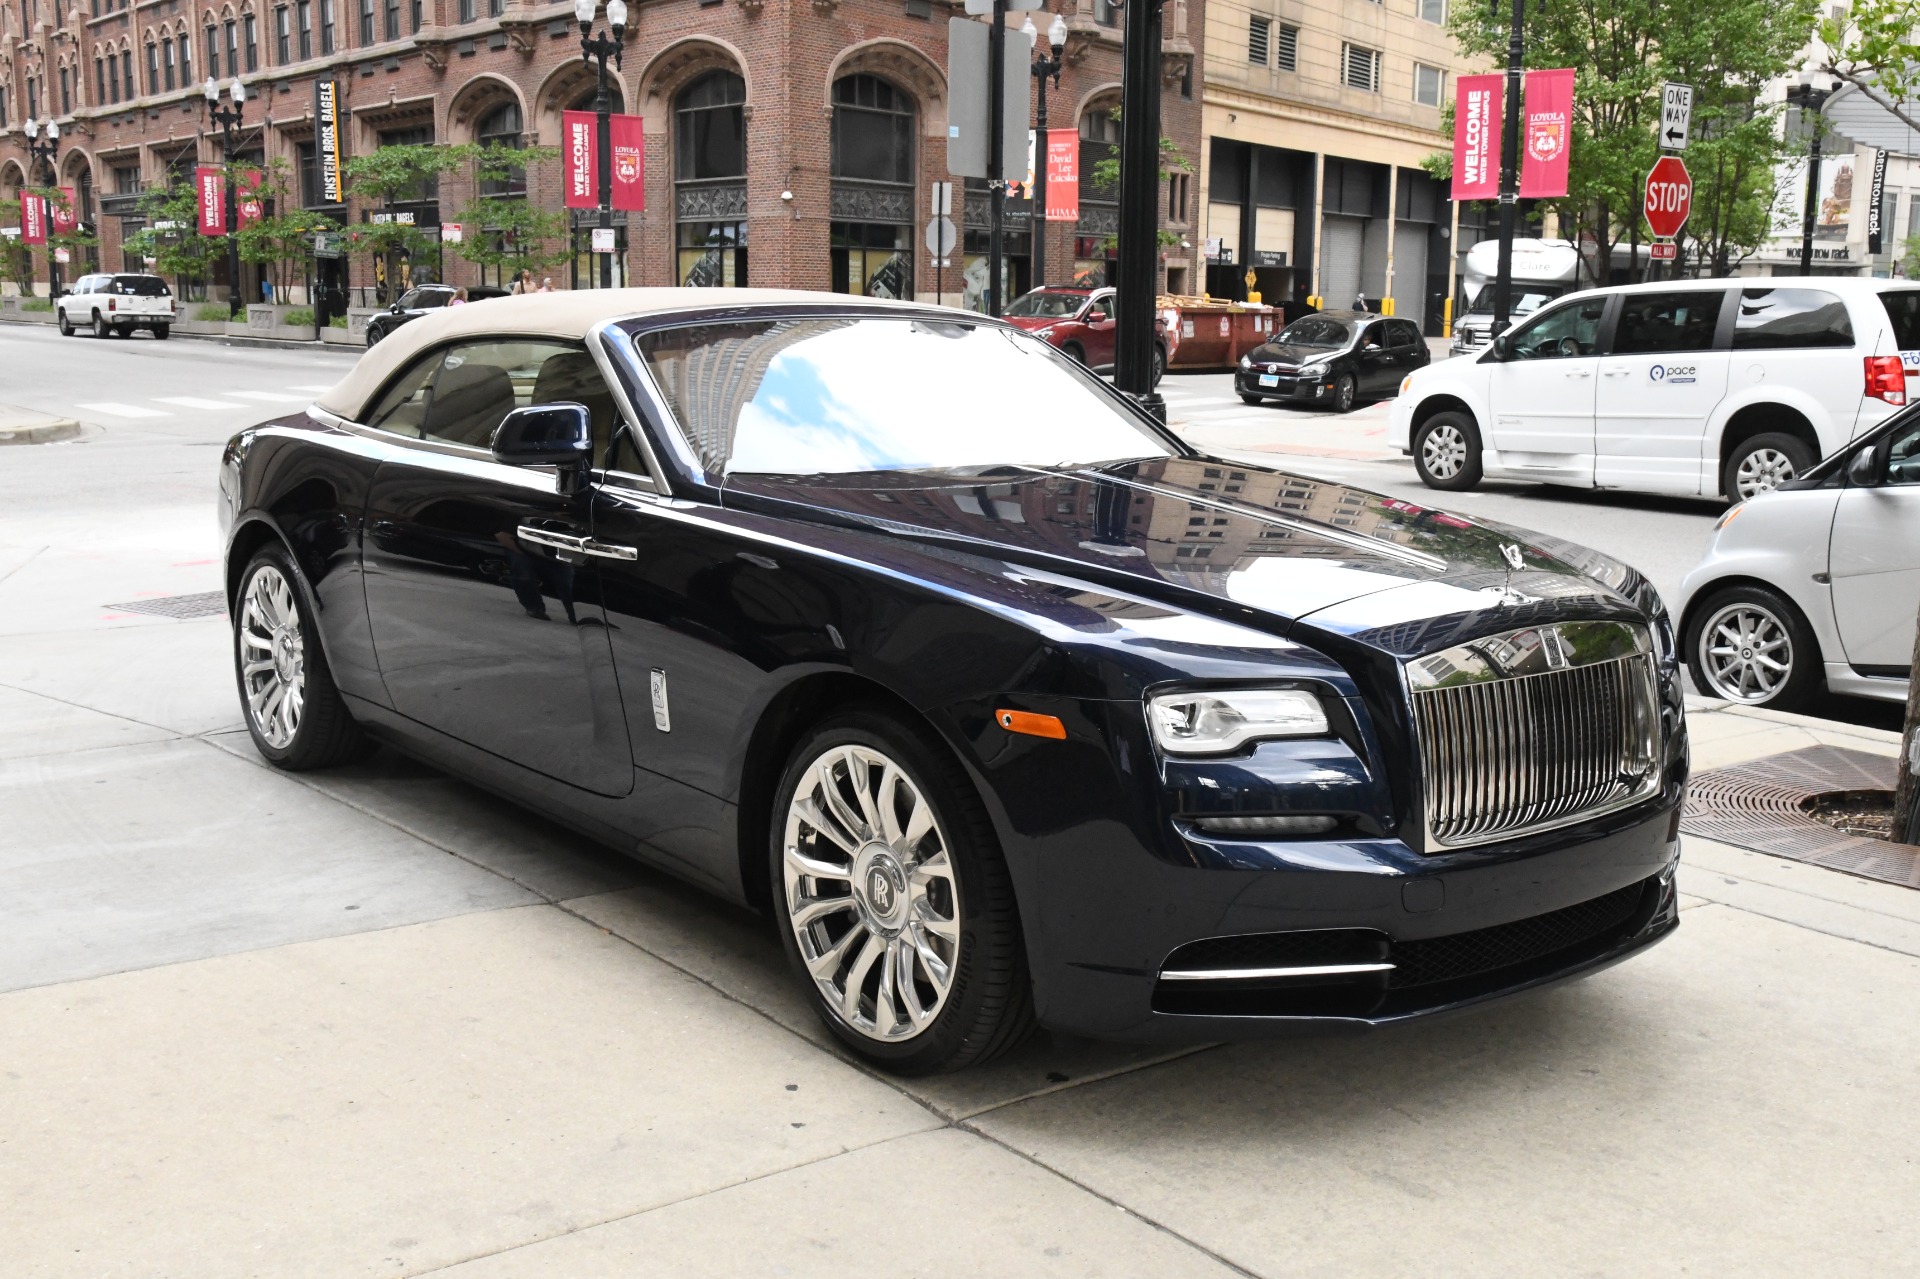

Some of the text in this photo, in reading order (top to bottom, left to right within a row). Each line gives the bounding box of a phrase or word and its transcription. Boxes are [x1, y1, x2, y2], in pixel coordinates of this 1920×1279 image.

[1667, 89, 1689, 107] ONE
[1530, 112, 1565, 121] LOYOLA
[1666, 108, 1688, 124] WAY
[320, 83, 336, 200] EINSTEIN BROS. BAGELS
[1464, 90, 1482, 185] WELCOME
[1479, 90, 1491, 185] WATER TOWER CAMPUS
[573, 123, 584, 196] WELCOME
[1049, 153, 1072, 164] David
[1059, 164, 1072, 172] Lee
[1049, 173, 1077, 182] Csicsko
[1648, 181, 1689, 213] STOP
[1869, 149, 1886, 235] ORDSTROM rack
[203, 176, 214, 227] WELCOME
[26, 197, 35, 237] WELCOME
[1046, 208, 1078, 217] LUMA
[1652, 245, 1663, 257] ALL
[1663, 246, 1674, 257] WAY
[1786, 246, 1850, 259] NORROM rack
[1520, 261, 1551, 271] Clare
[1901, 351, 1920, 366] F6
[1667, 366, 1696, 377] pace
